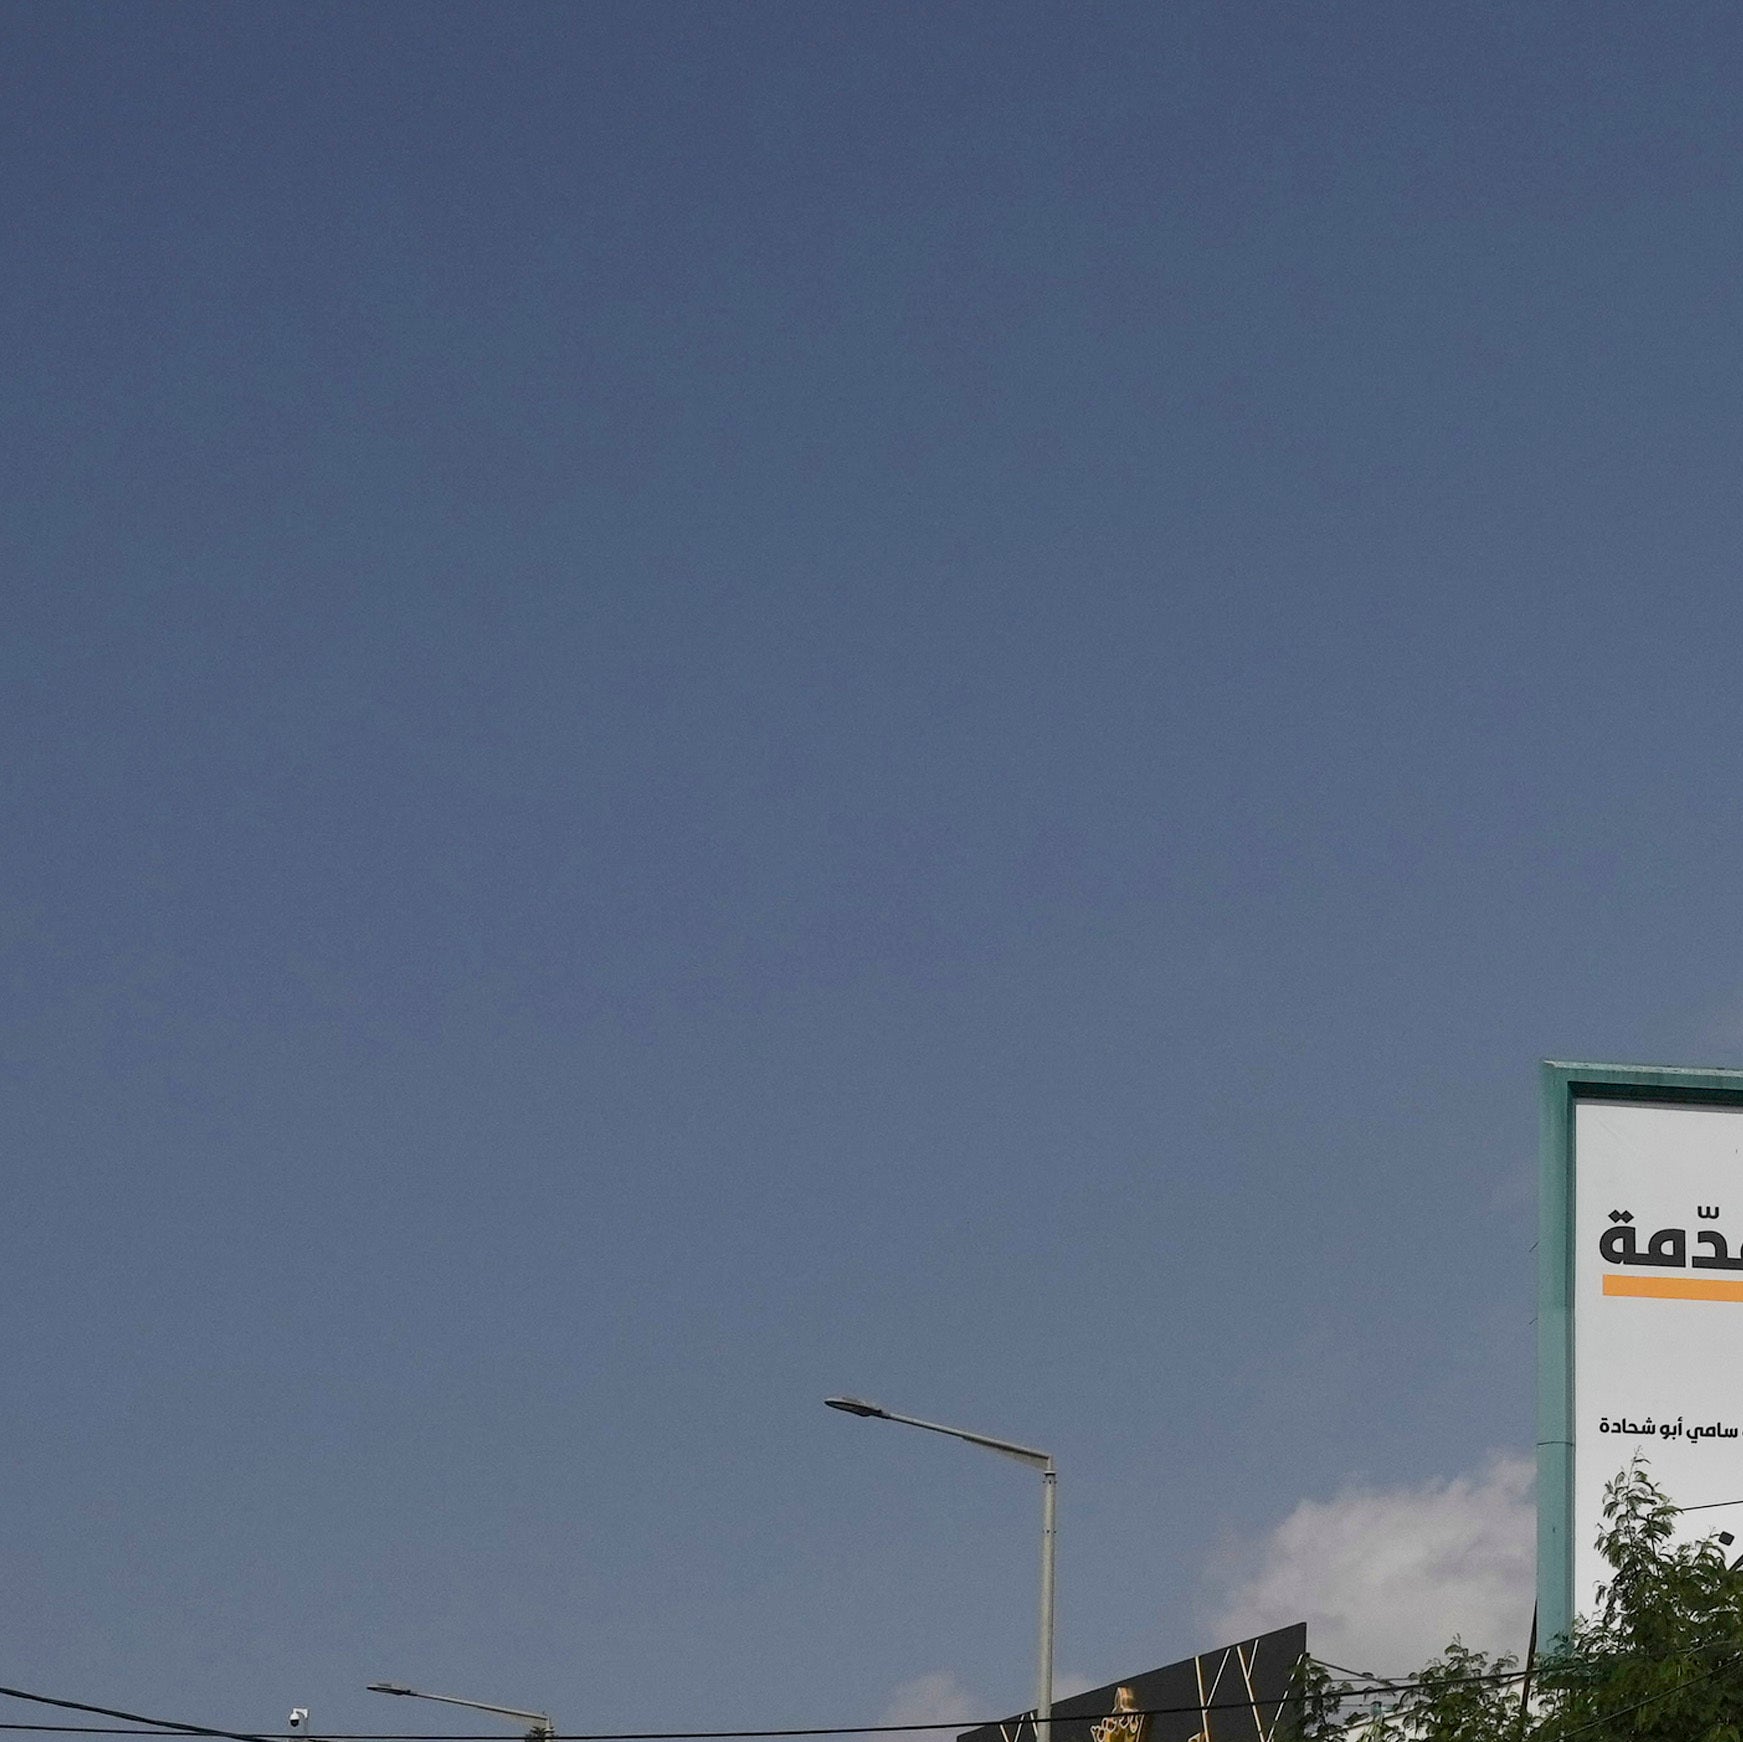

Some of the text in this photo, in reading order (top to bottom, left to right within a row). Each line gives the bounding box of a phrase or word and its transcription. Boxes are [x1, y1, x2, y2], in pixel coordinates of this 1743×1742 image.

[1599, 1417, 1653, 1436] شحادة
[1660, 1417, 1683, 1440] أبو
[1687, 1420, 1738, 1444] سامي
